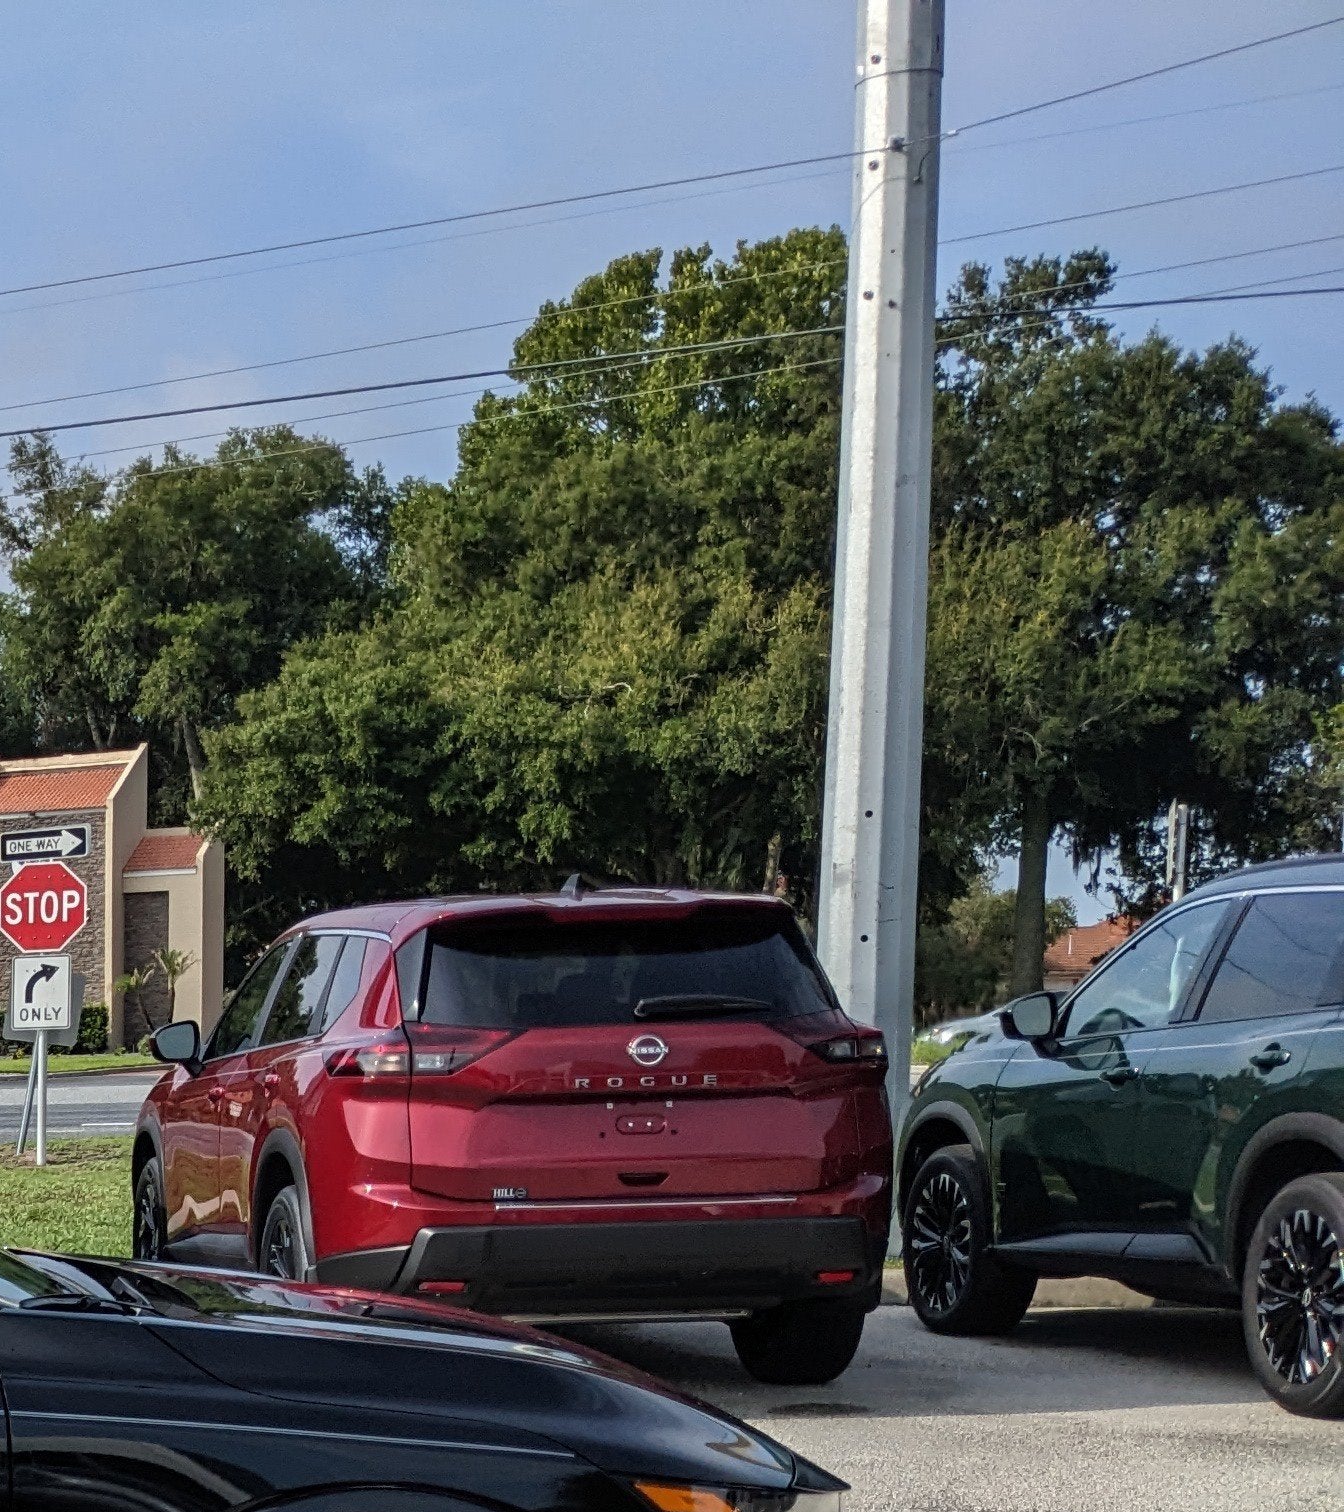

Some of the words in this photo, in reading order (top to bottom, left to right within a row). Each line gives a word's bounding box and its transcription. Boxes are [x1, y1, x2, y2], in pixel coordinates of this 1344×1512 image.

[9, 840, 32, 853] ONE
[35, 838, 60, 851] WAY
[4, 890, 80, 925] STOP
[19, 1007, 62, 1022] ONLY
[627, 1045, 669, 1055] NISSAN
[575, 1074, 717, 1089] ROGUE
